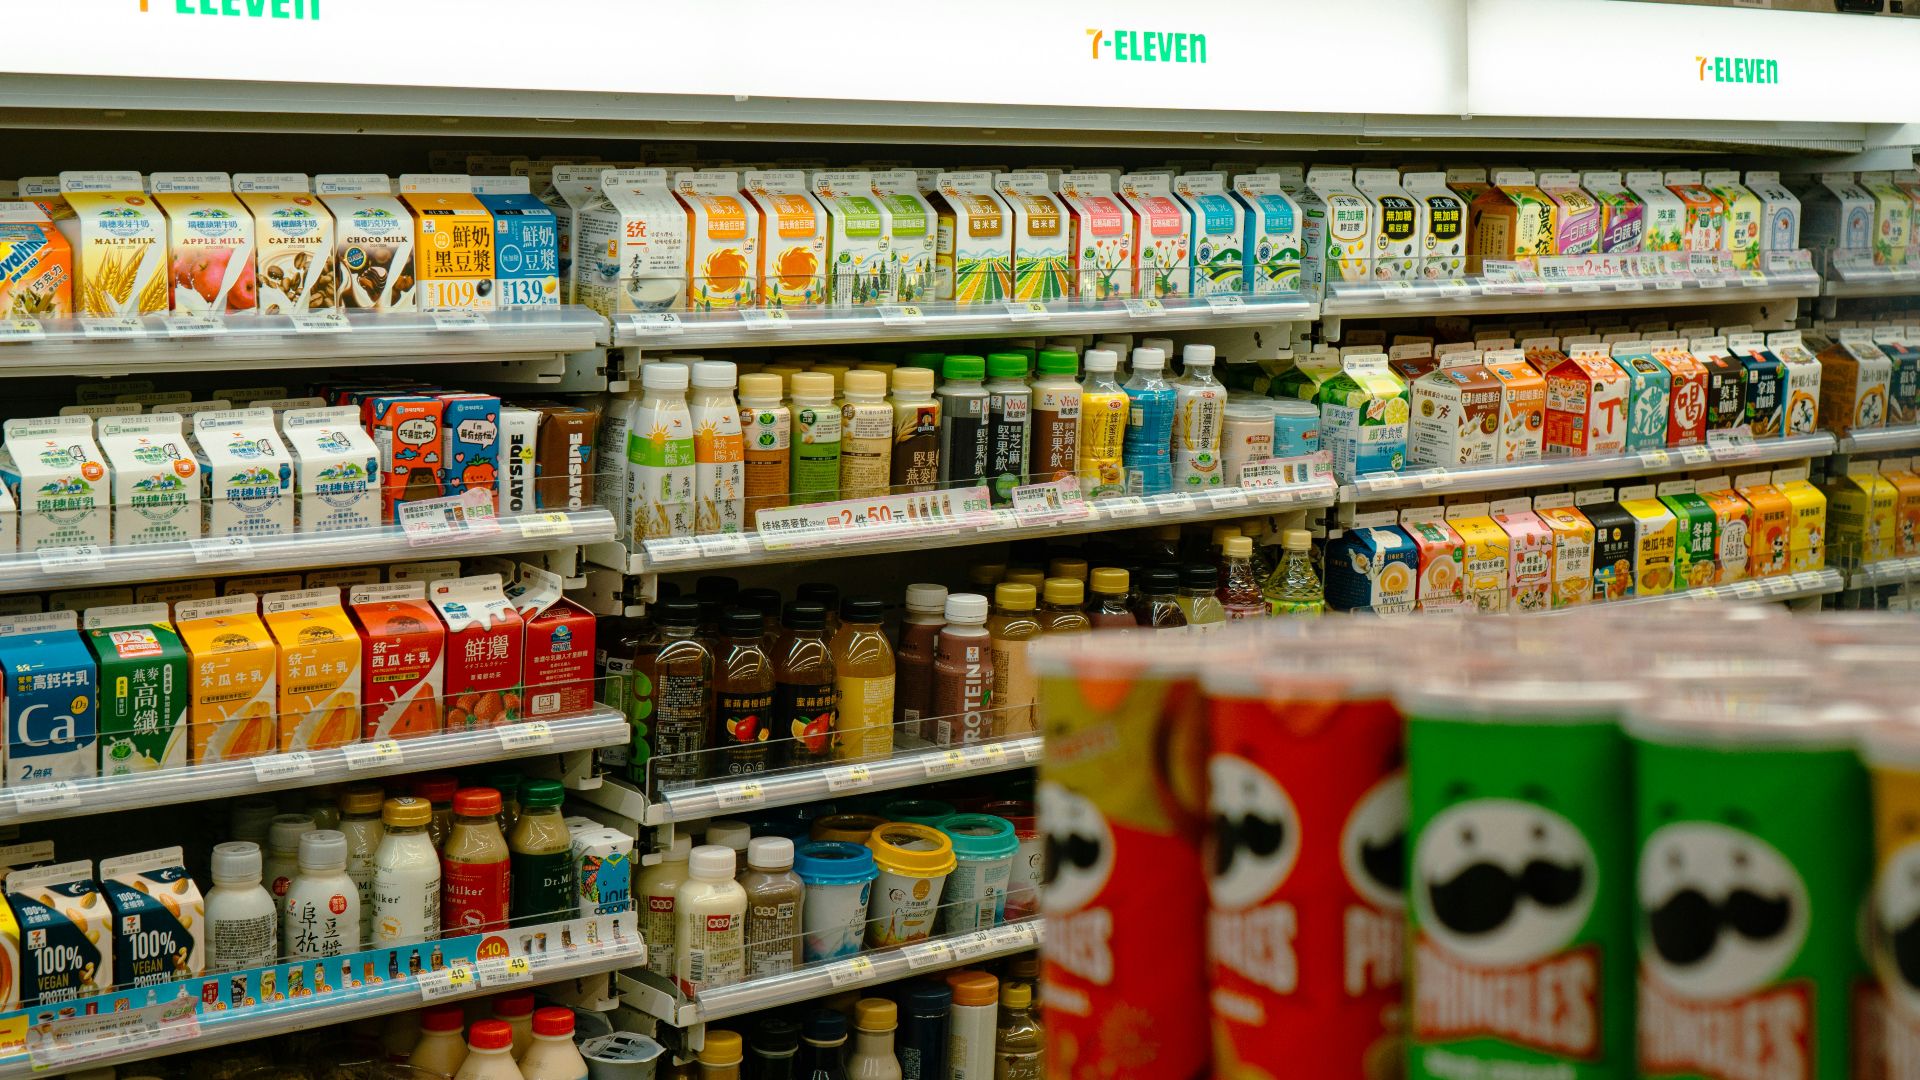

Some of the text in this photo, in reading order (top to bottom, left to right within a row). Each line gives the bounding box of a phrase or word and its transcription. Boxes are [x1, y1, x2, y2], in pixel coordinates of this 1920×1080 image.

[1086, 29, 1207, 63] 7-ELEVEN
[1696, 56, 1779, 84] 7-ELEVEN
[1336, 209, 1365, 222] 無加糖
[1385, 210, 1412, 222] 無加糖
[1433, 210, 1459, 222] 無加糖
[452, 225, 490, 249] 鮮奶
[522, 225, 555, 248] 鮮奶
[1560, 219, 1598, 241] 一日蔬果
[1604, 219, 1642, 243] 一日蔬果
[94, 236, 157, 246] MALT MILK
[182, 237, 245, 246] APPLE MILK
[297, 236, 323, 244] MILK
[346, 235, 409, 244] CHOCO MILK
[434, 249, 491, 273] 黑豆漿
[524, 249, 556, 271] 豆漿
[32, 264, 63, 292] 巧克力
[629, 253, 644, 293] 杏仁茶
[436, 281, 475, 307] 10.9
[660, 313, 675, 322] 25
[1720, 385, 1739, 399] 莫卡
[1757, 381, 1776, 395] 拿鐵
[1718, 399, 1738, 413] 咖啡
[1755, 395, 1775, 409] 咖啡
[1200, 401, 1214, 449] 純濃燕麥
[664, 441, 691, 454] 統一
[713, 439, 740, 450] 統一
[995, 425, 1010, 472] 堅果飲
[1009, 434, 1022, 465] 芝麻
[1050, 421, 1064, 468] 堅果飲
[1063, 430, 1076, 460] 綜合
[664, 454, 691, 466] 陽光
[714, 450, 740, 461] 陽光
[913, 451, 935, 468] 堅果
[509, 433, 524, 512] OATSIDE
[568, 432, 583, 511] OATSIDE
[226, 487, 281, 501] 瑞穗鮮乳
[315, 481, 369, 496] 瑞穗鮮乳
[37, 497, 97, 511] 瑞穗鮮乳
[130, 494, 189, 509] 瑞穗鮮乳
[1642, 536, 1674, 552] 地瓜牛奶
[1566, 559, 1582, 571] 奶茶
[372, 640, 399, 655] 統一
[371, 650, 431, 667] 西瓜牛乳
[132, 667, 160, 684] 燕麥
[200, 669, 264, 688] 木瓜牛乳
[288, 661, 349, 679] 木瓜牛乳
[33, 669, 90, 691] 高鈣牛乳
[133, 682, 160, 737] 高纖
[963, 663, 982, 744] ROTEIN
[17, 703, 76, 748] Ca
[116, 891, 142, 903] 100%
[446, 883, 485, 897] Milker
[21, 906, 48, 917] 100%
[295, 901, 320, 953] 阜杭
[1013, 923, 1025, 933] 30
[321, 917, 343, 958] 豆漿
[975, 932, 987, 941] 30
[129, 930, 177, 962] 100%
[34, 944, 83, 977] 100%
[132, 959, 164, 977] VEGAN
[511, 958, 525, 969] 40
[37, 973, 70, 991] VEGAN
[133, 970, 173, 990] PROTEIN
[451, 968, 465, 979] 40
[39, 987, 78, 1007] PROTEIN
